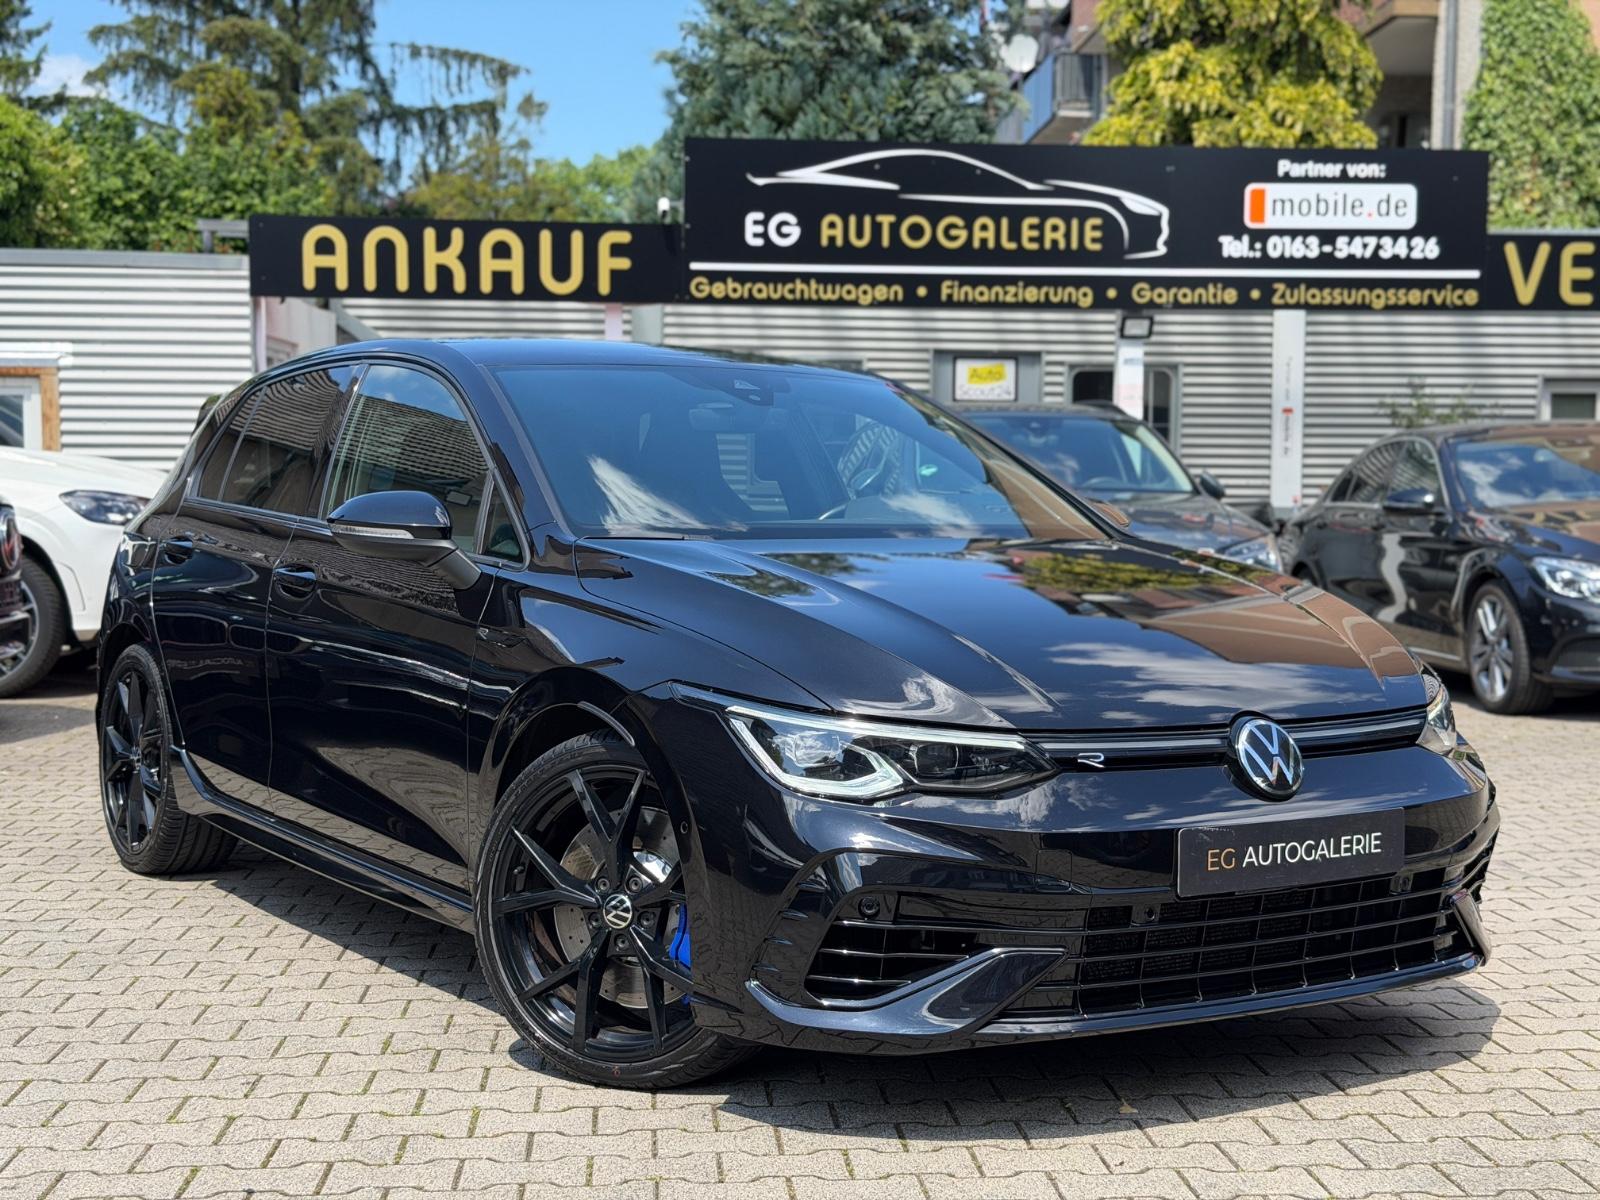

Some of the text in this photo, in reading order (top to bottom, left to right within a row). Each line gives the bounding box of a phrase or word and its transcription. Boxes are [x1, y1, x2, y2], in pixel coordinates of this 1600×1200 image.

[1277, 159, 1387, 179] Partner von:
[1271, 193, 1408, 218] mobile.de
[744, 212, 1104, 252] EG AUTOGALERIE
[1218, 235, 1441, 260] Tel.: 0163-5473426
[301, 223, 633, 297] ANKAUF
[1503, 241, 1597, 307] VE
[689, 277, 1481, 309] Gebrauchtwagen Finanzierung Garantie Zulassungsservice
[1206, 832, 1382, 871] EG AUTOGALERIE
